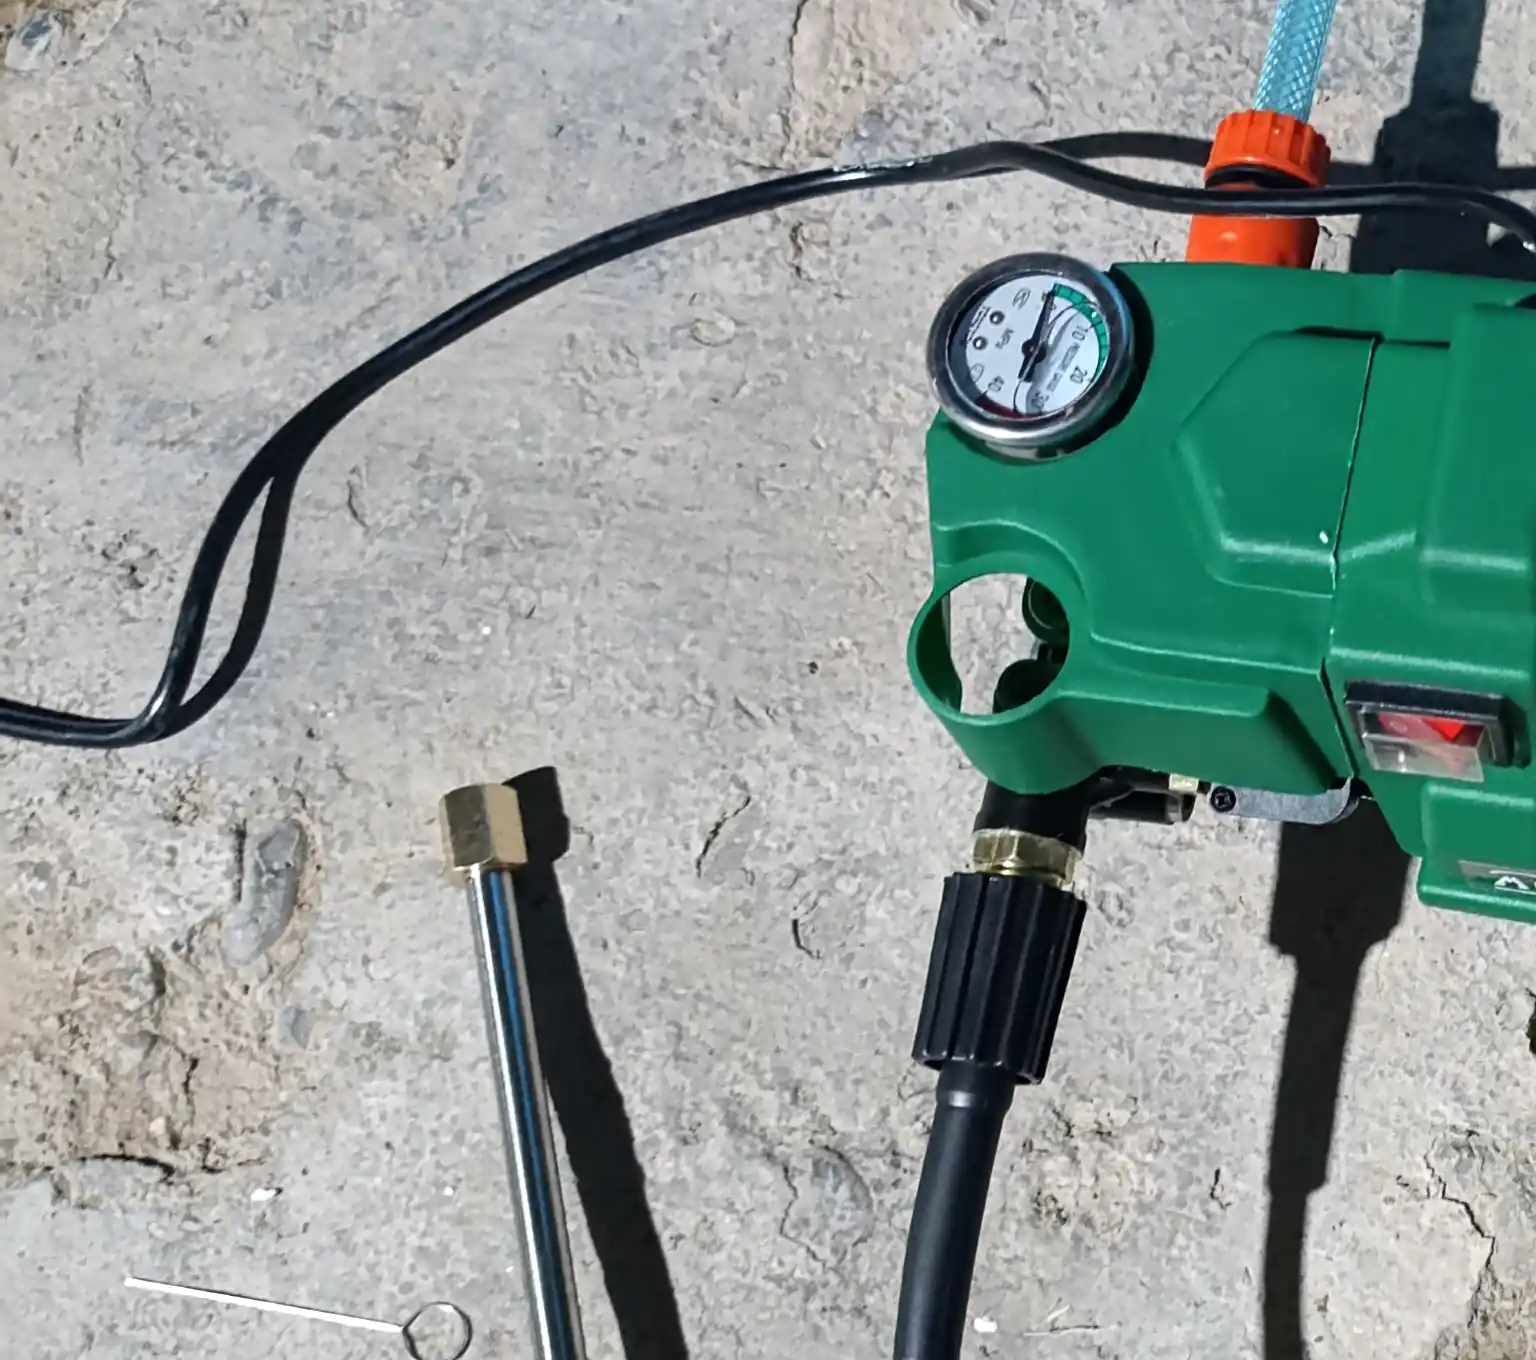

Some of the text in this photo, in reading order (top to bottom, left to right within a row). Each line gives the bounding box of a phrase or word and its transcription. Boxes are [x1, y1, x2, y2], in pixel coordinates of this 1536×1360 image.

[1071, 325, 1089, 341] 10
[1069, 365, 1088, 384] 20
[987, 375, 1005, 393] 40
